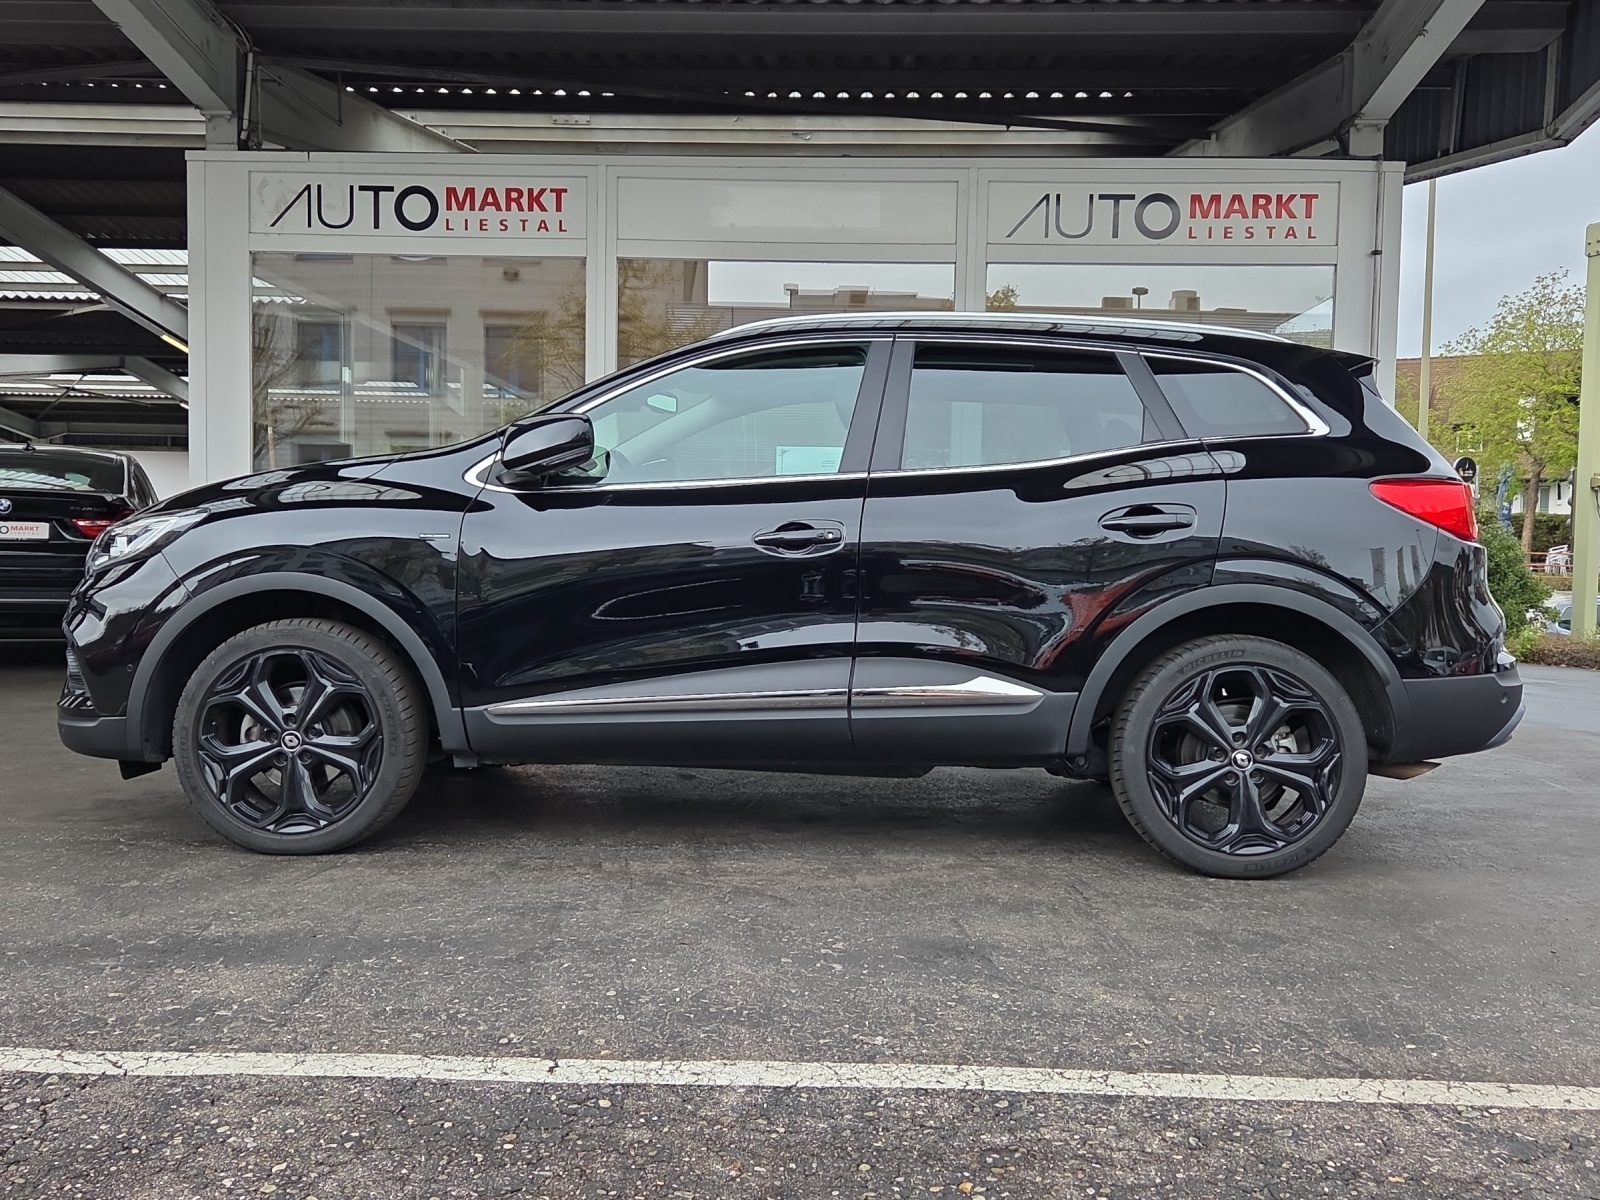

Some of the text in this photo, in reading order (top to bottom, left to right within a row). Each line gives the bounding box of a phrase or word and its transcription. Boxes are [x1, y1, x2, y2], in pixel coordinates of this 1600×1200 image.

[269, 184, 568, 231] AUTO MARKT
[1005, 192, 1319, 240] AUTO MARKT
[445, 218, 568, 232] LIESTAL
[1188, 226, 1317, 239] LIESTAL
